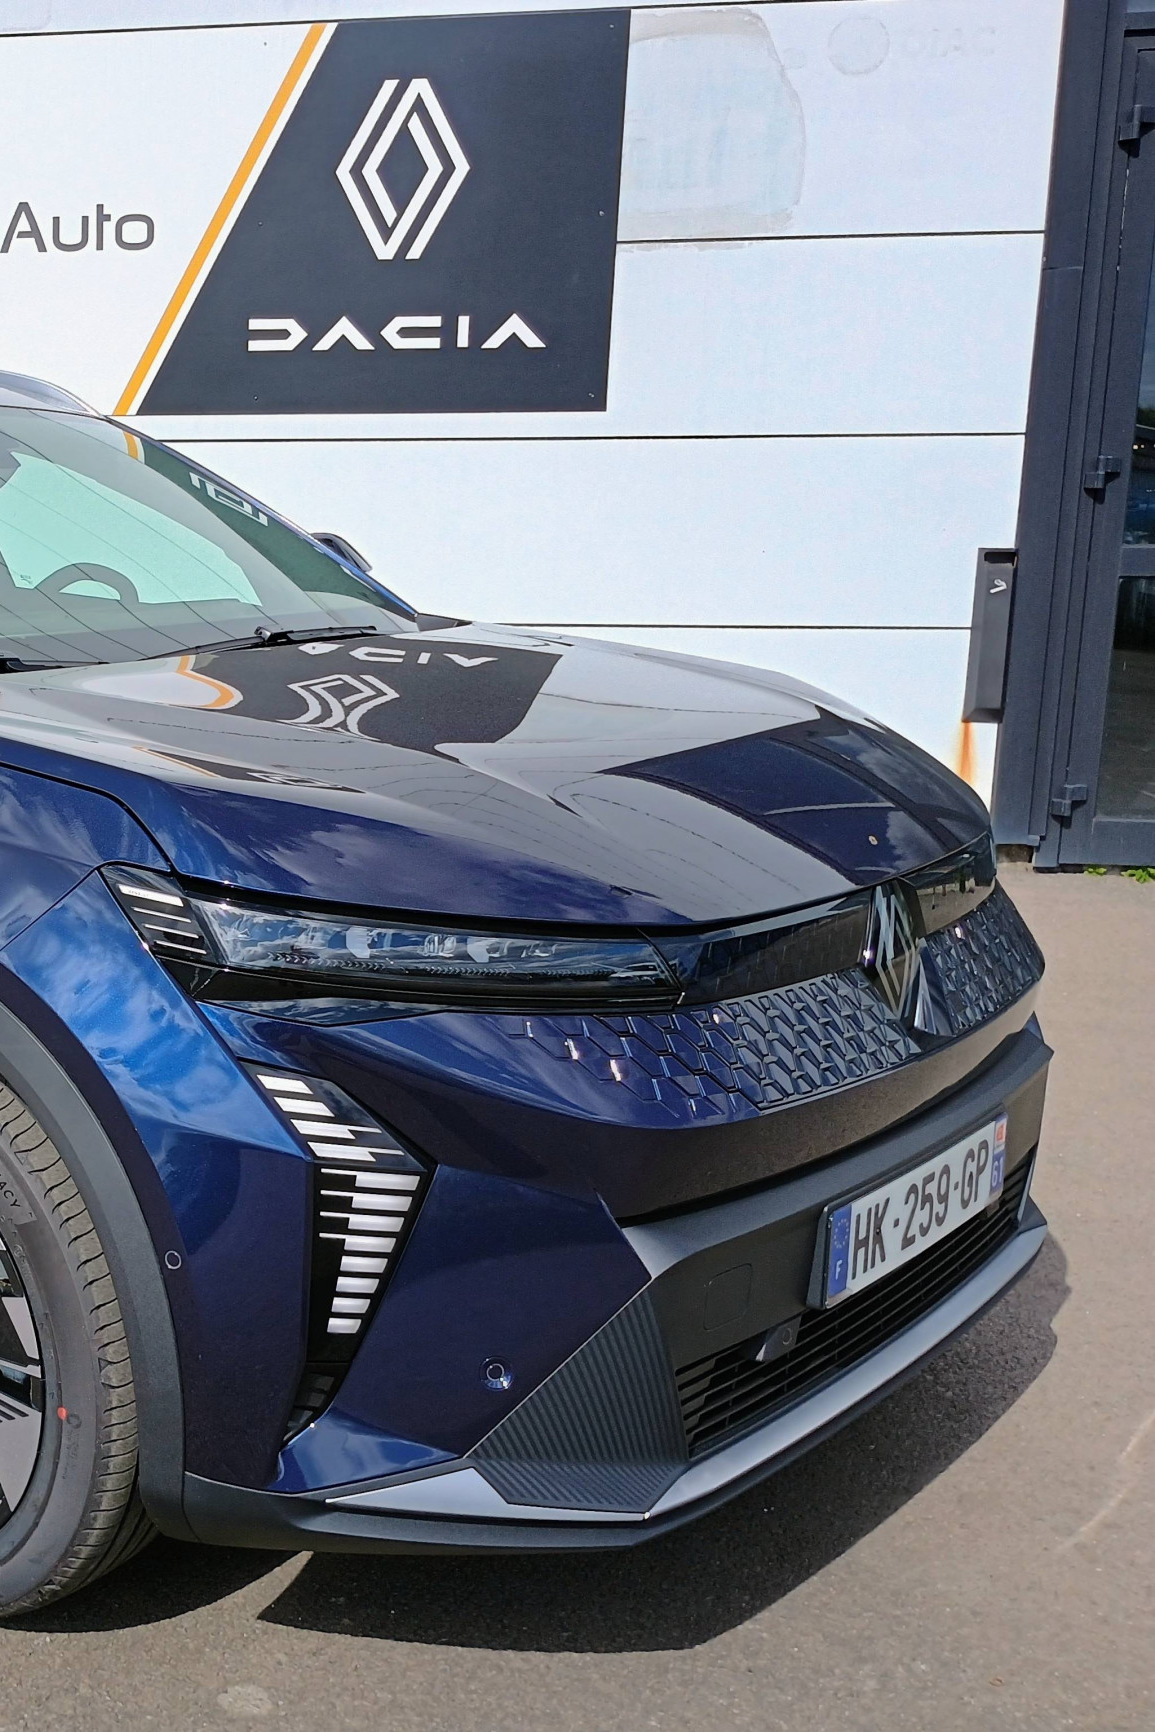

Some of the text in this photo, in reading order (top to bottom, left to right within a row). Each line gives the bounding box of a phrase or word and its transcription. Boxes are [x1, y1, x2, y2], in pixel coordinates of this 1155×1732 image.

[0, 201, 155, 252] Auto
[248, 313, 546, 351] DACIA
[835, 1139, 1003, 1280] F HK-259-GP 61
